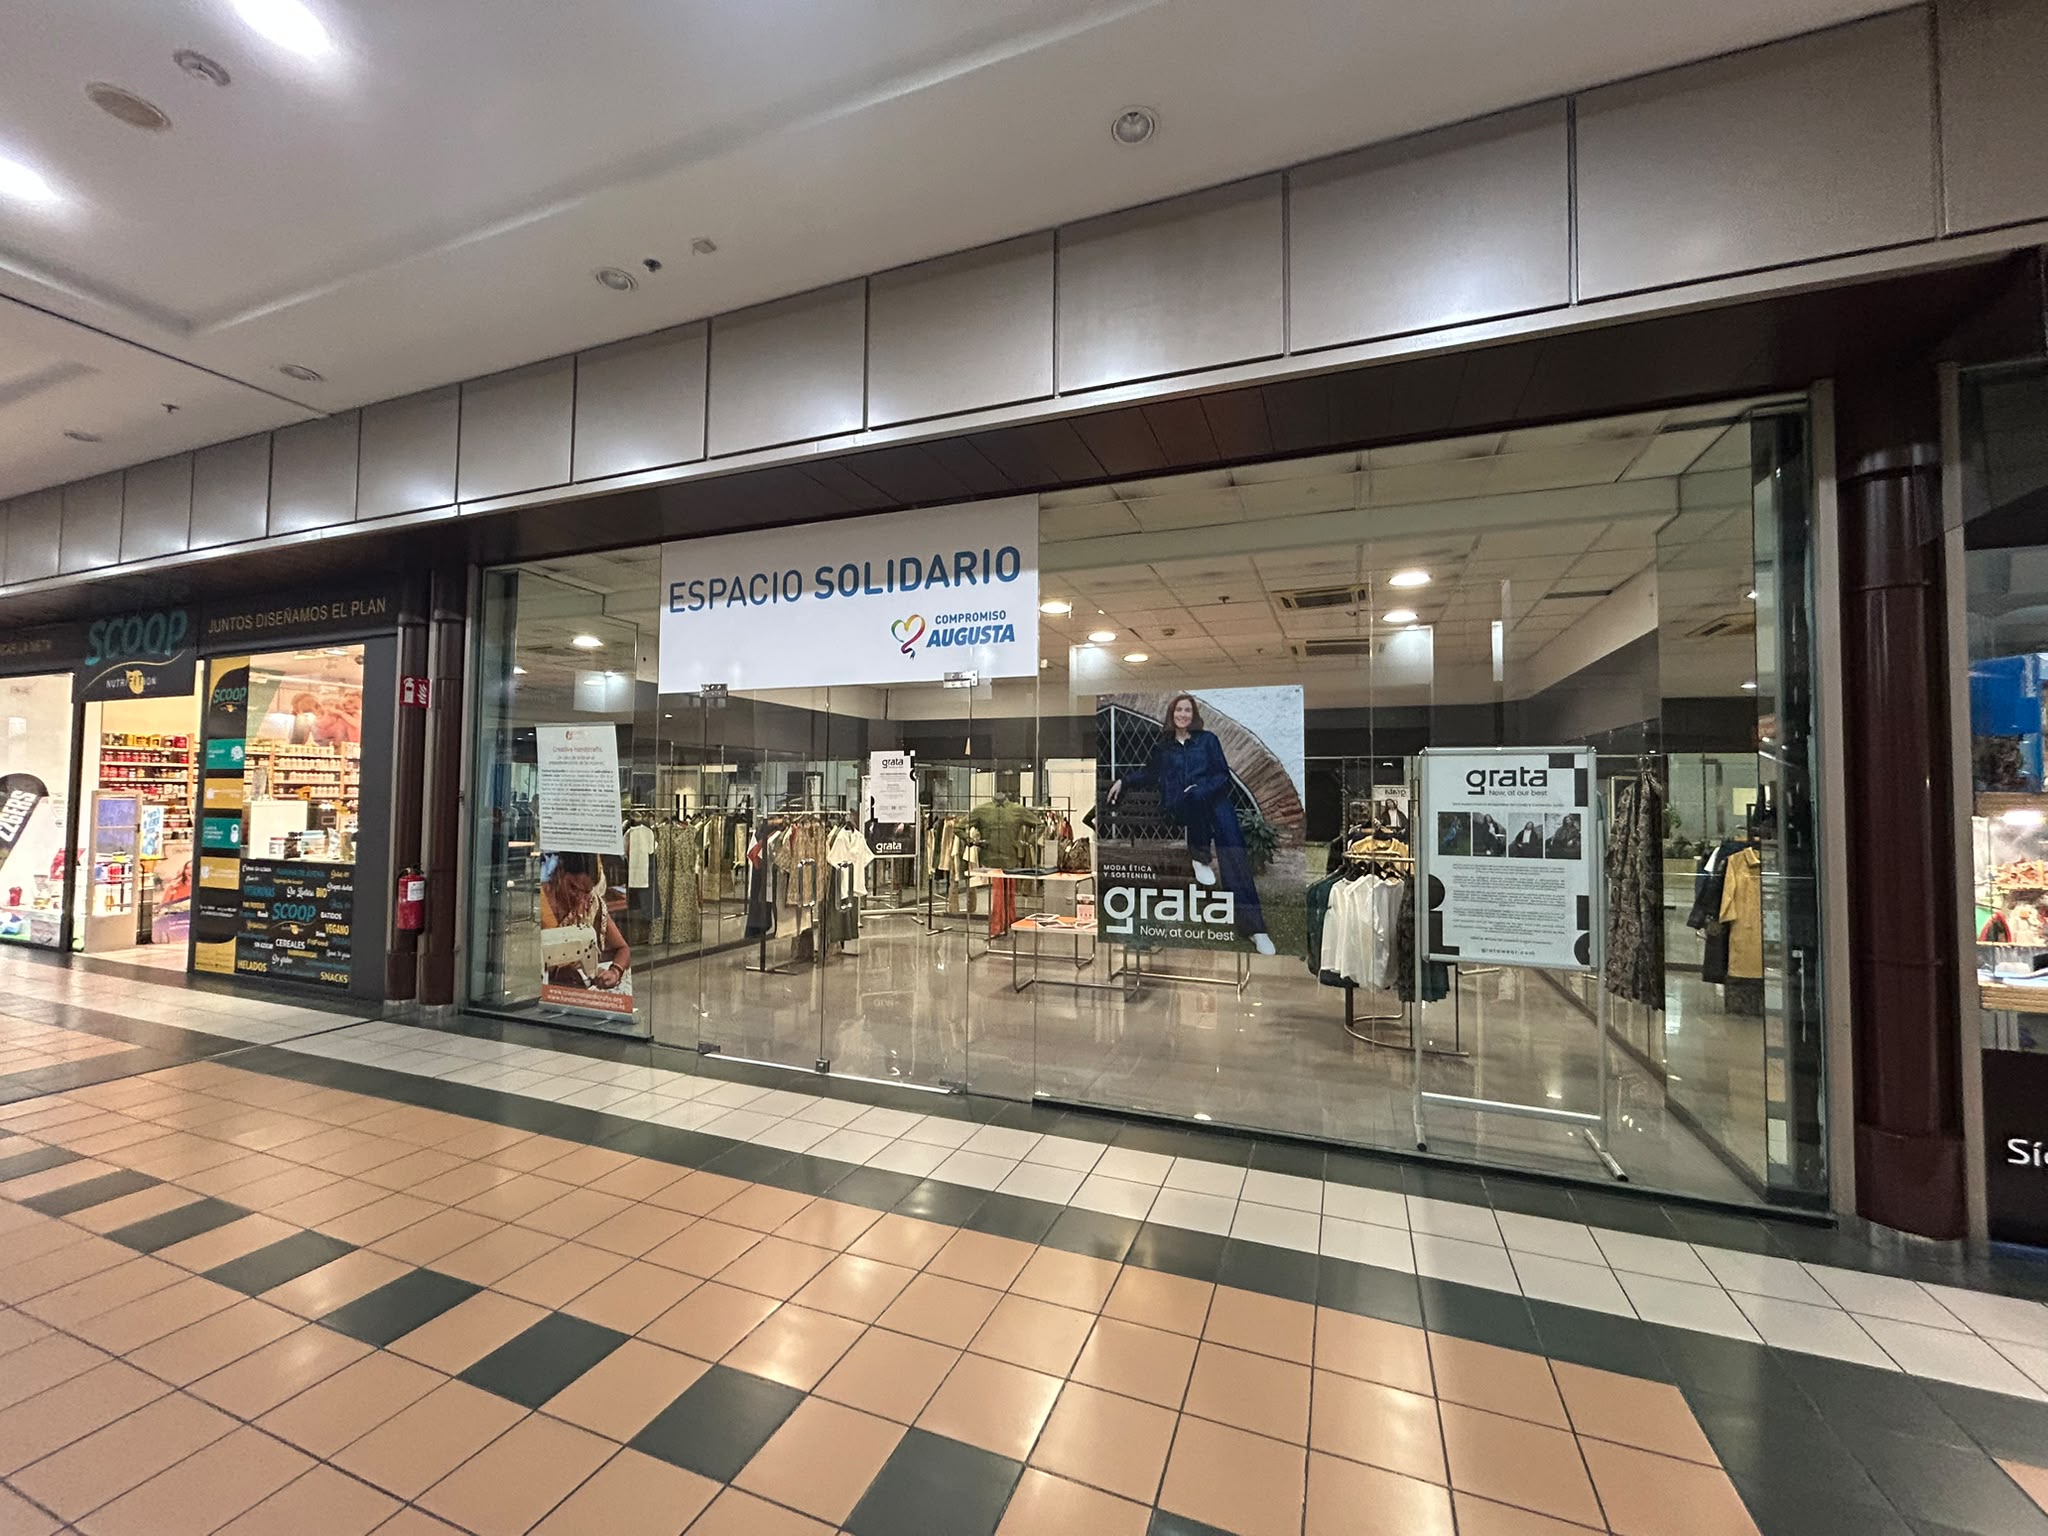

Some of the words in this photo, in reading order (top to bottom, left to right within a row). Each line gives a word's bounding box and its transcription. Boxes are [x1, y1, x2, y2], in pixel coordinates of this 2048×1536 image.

[670, 569, 802, 613] ESPACIO
[814, 546, 1021, 599] SOLIDARIO
[208, 615, 253, 633] JUNTOS
[256, 605, 328, 628] DISEÑAMOS
[332, 603, 347, 618] EL
[351, 597, 386, 616] PLAN
[935, 610, 1007, 625] COMPROMISO
[84, 609, 188, 666] SCOOP
[926, 623, 1015, 648] AUGUSTA
[213, 687, 247, 703] SCOOP
[881, 758, 904, 769] grata
[1465, 766, 1548, 796] grata
[1530, 789, 1548, 797] best
[875, 841, 902, 854] grata
[1128, 863, 1152, 872] ÉTICA
[1110, 871, 1156, 880] SOSTENIBLE
[271, 902, 317, 922] SCOOP
[320, 911, 342, 920] BATIDOS
[1103, 883, 1235, 934] grata
[325, 923, 350, 936] VEGANO
[1139, 925, 1168, 939] Now,
[1169, 928, 1182, 938] at
[1184, 929, 1205, 939] our
[1207, 929, 1234, 941] best
[275, 938, 306, 950] CEREALES
[237, 960, 268, 973] HELADOS
[320, 971, 349, 984] SNACKS
